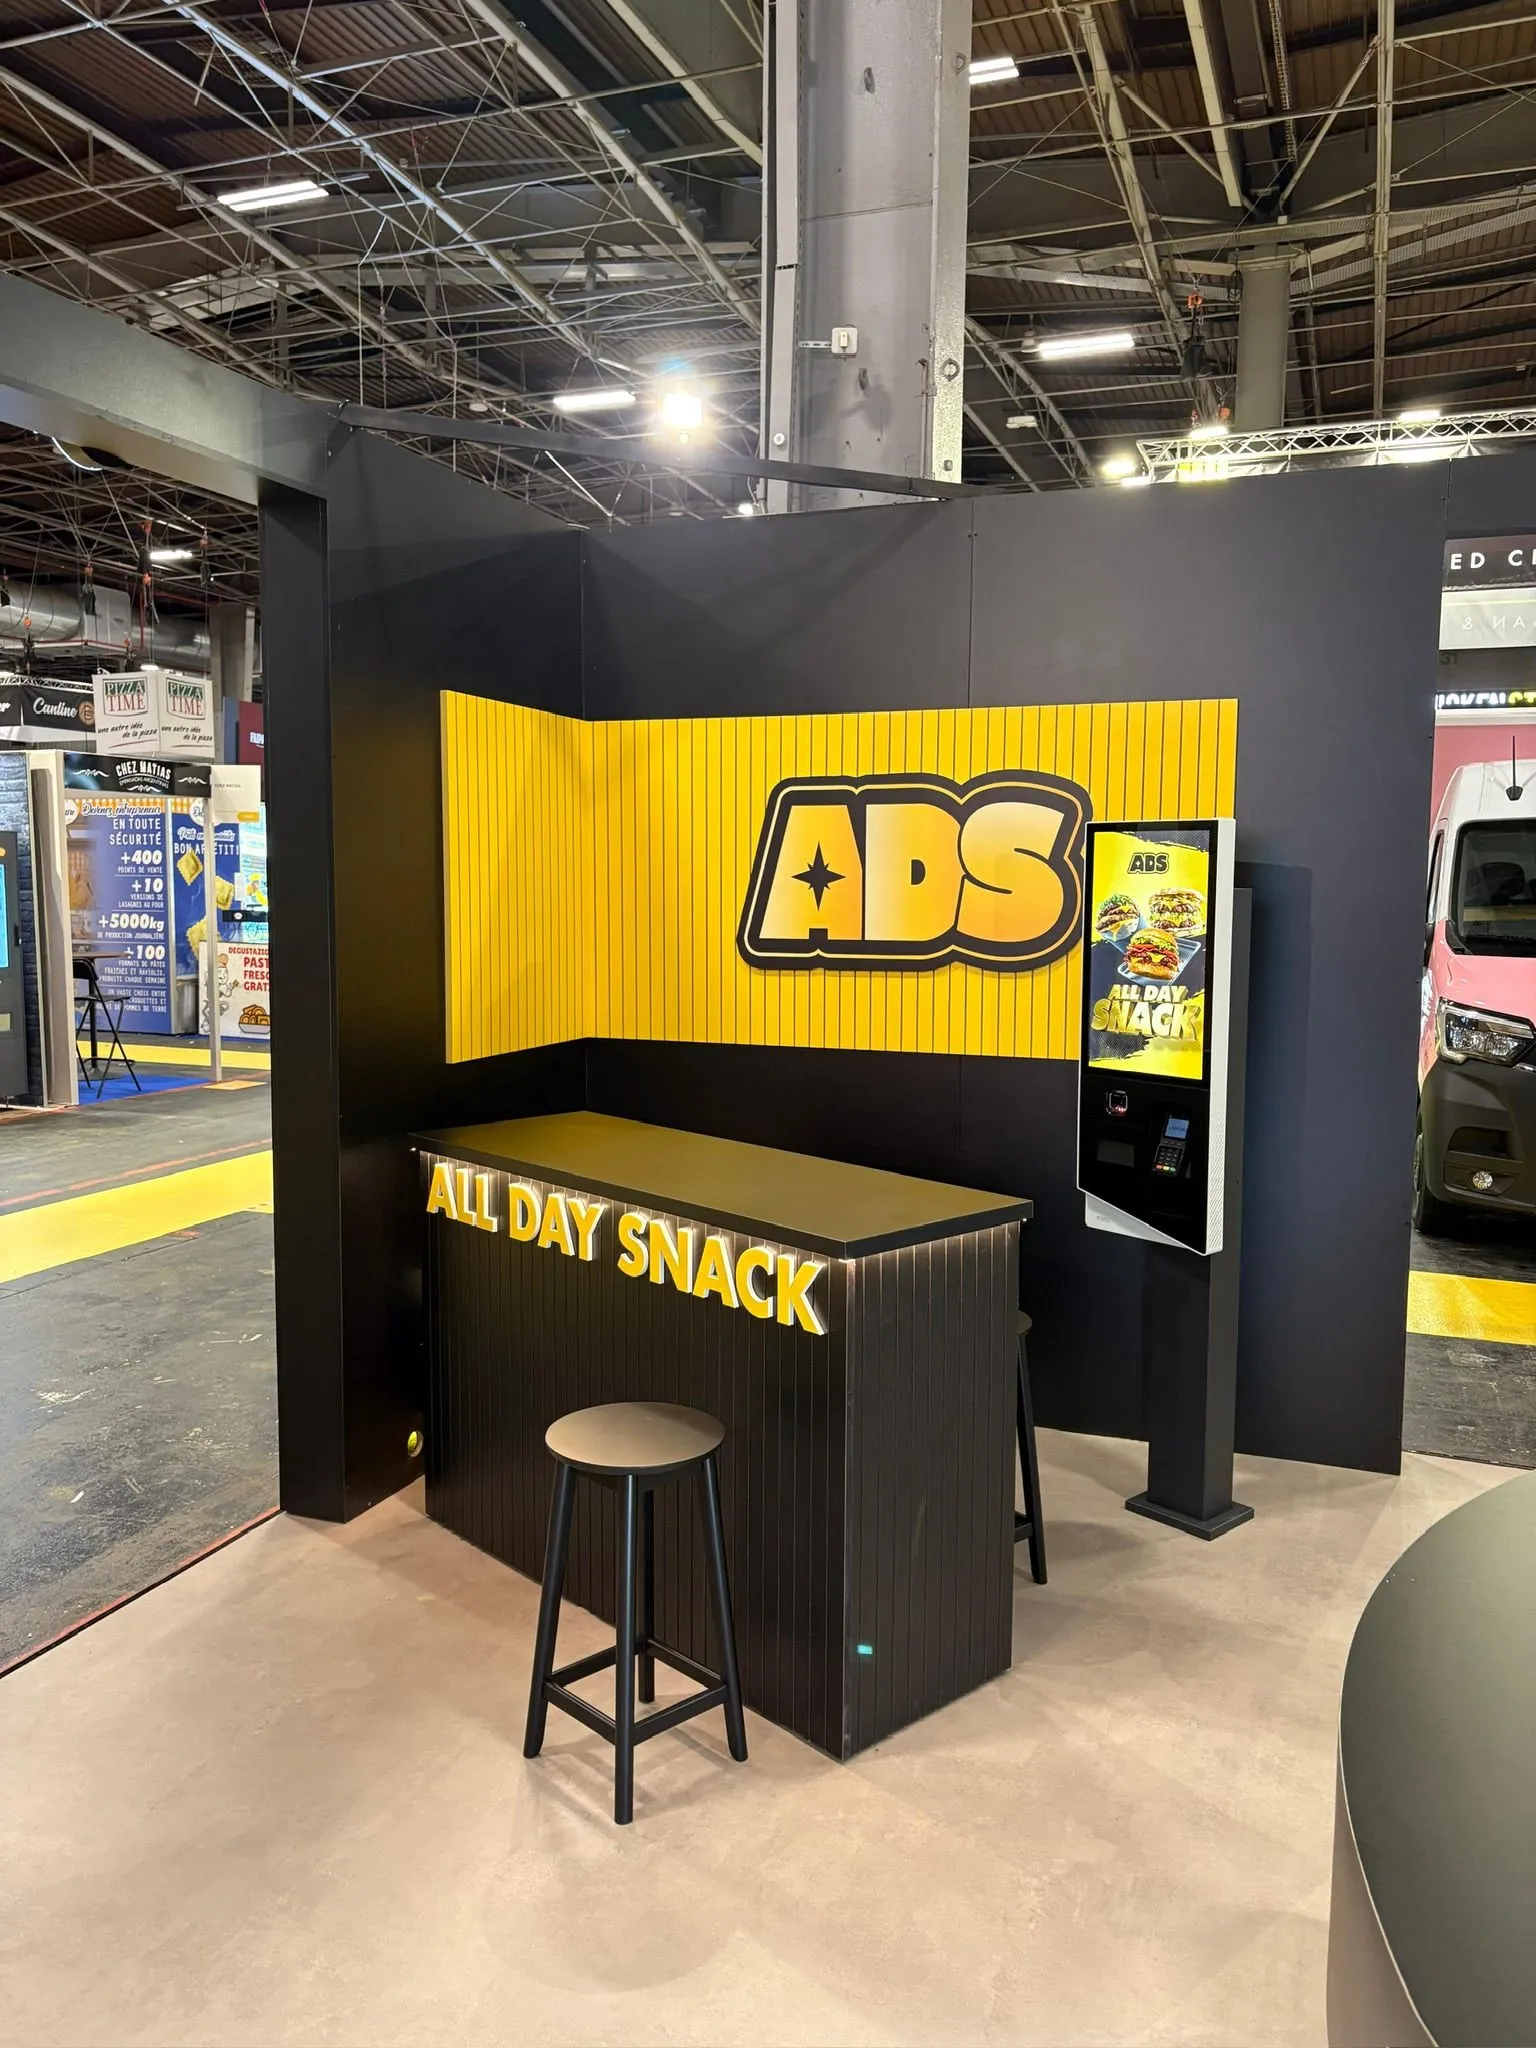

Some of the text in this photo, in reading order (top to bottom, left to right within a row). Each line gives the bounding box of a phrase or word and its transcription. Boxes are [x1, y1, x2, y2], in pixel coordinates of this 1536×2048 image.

[1508, 548, 1536, 567] C
[106, 681, 145, 695] PIZZA
[169, 684, 204, 700] PIZZA
[106, 694, 146, 712] TIME
[169, 695, 204, 716] TIME
[111, 723, 128, 732] autre
[122, 731, 130, 739] de
[138, 728, 158, 740] pizza
[183, 733, 191, 741] de
[198, 735, 213, 744] pizza
[116, 760, 172, 780] CHEZ MATIAS
[113, 818, 161, 830] EN TOUTE
[109, 831, 161, 845] SÉCURITÉ
[121, 850, 163, 865] +400
[1129, 853, 1168, 873] ADS
[757, 799, 1067, 944] ADS
[132, 878, 163, 893] +10
[99, 913, 165, 932] +5000kg
[124, 945, 166, 960] +100
[1107, 984, 1187, 1003] ALL DAY
[1091, 999, 1201, 1040] SNACK
[426, 1162, 826, 1336] ALL DAY SNACK
